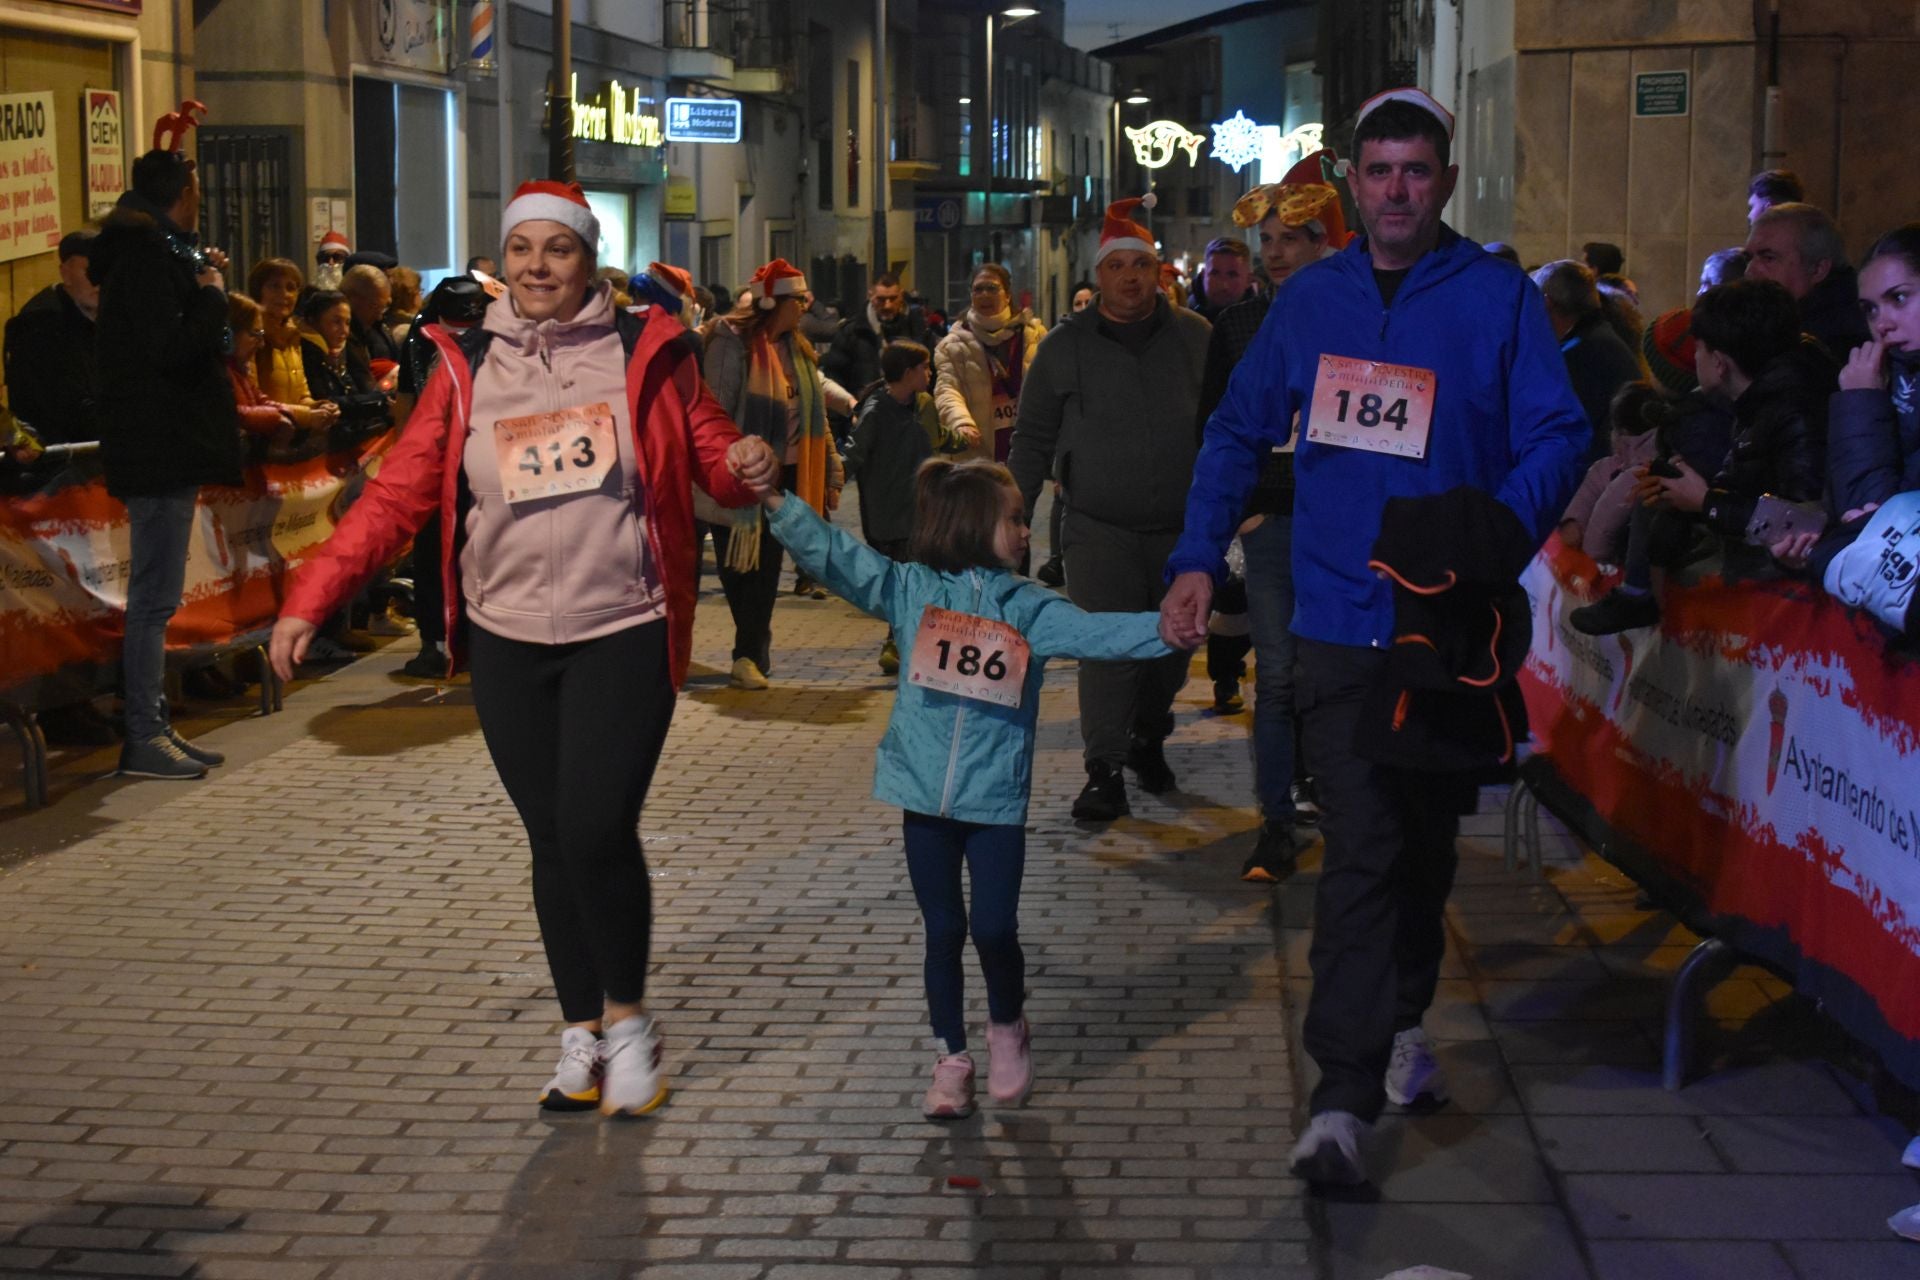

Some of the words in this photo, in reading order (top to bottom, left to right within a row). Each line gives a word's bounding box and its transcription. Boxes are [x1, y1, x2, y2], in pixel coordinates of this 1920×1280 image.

[91, 122, 119, 145] CIEM
[691, 118, 734, 128] Moderna
[1335, 389, 1409, 432] 184
[518, 436, 596, 476] 413
[935, 639, 1007, 681] 186
